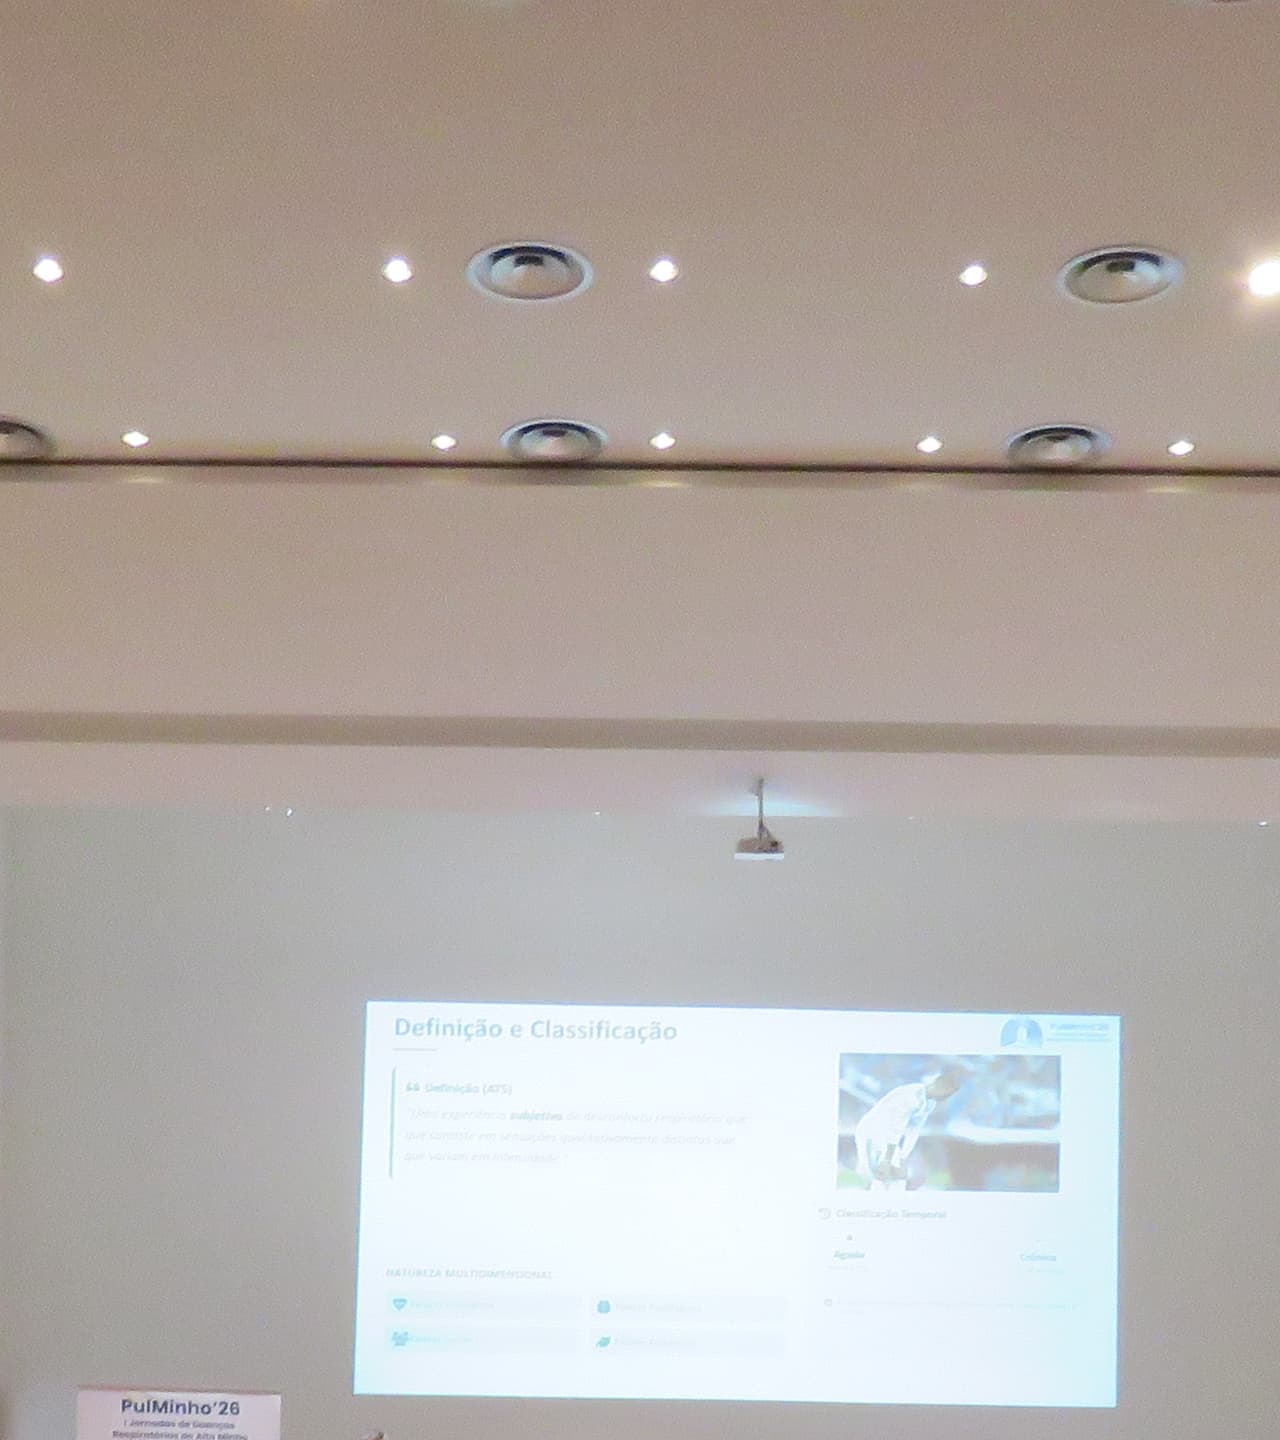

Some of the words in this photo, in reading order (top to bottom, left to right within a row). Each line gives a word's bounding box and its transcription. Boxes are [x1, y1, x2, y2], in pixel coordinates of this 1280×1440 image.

[394, 1017, 503, 1043] Definição
[509, 1023, 523, 1038] e
[530, 1020, 678, 1044] Classificação
